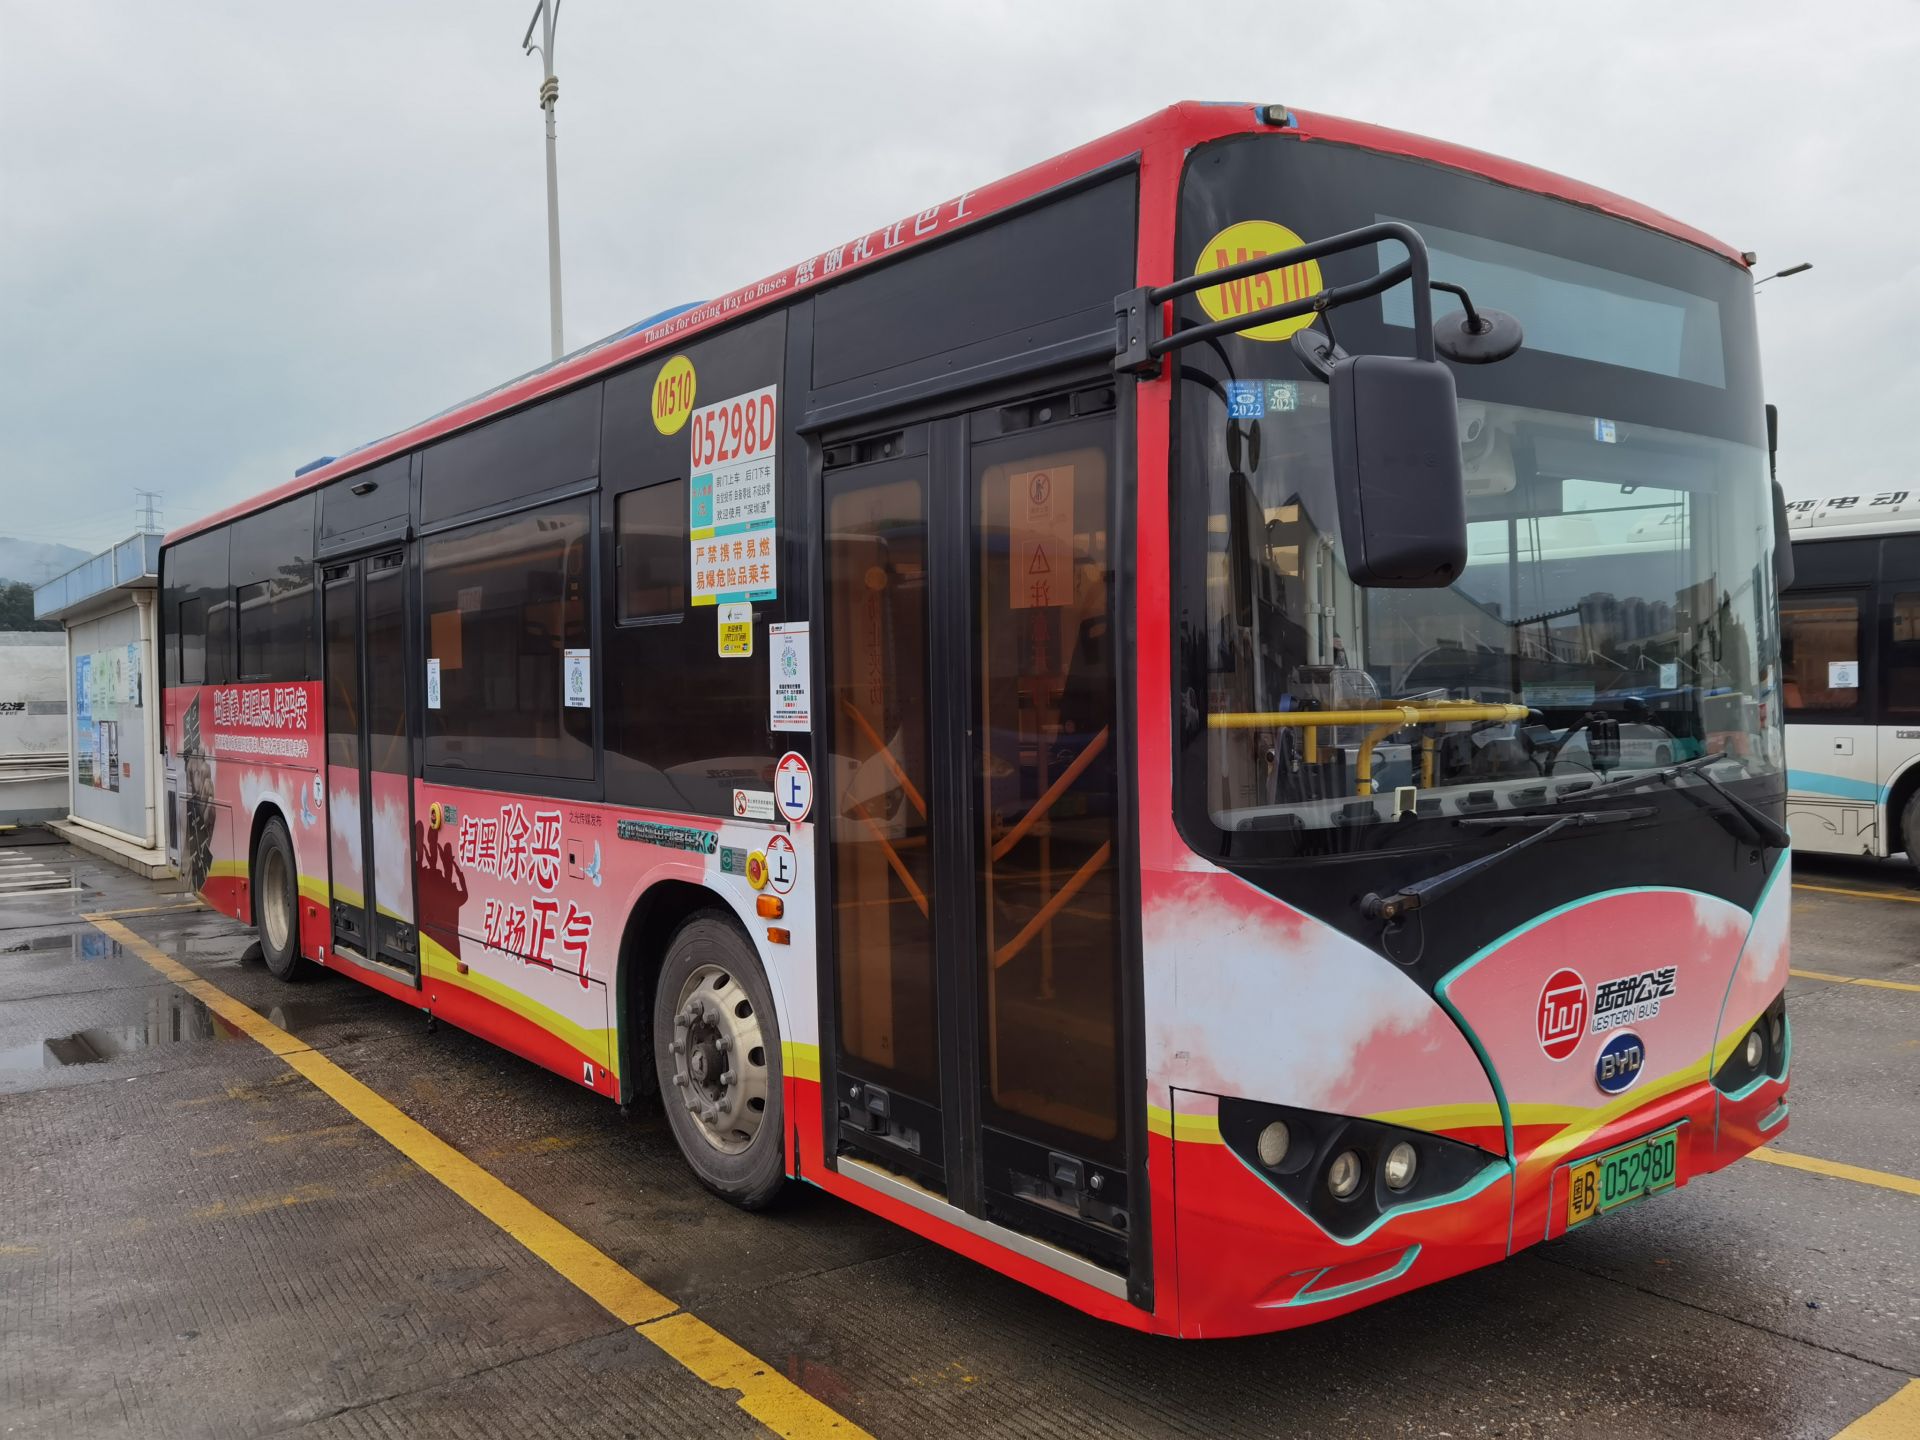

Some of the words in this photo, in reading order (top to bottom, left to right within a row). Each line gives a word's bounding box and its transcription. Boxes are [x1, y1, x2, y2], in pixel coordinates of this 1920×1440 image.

[794, 193, 976, 287] 感谢礼让巴士
[644, 322, 674, 344] Thanks
[676, 317, 689, 331] for
[691, 303, 721, 325] Giving
[722, 295, 742, 312] Way
[744, 289, 754, 303] to
[756, 275, 787, 297] Buses
[656, 370, 692, 419] M510
[1232, 404, 1262, 416] 2022
[1270, 398, 1295, 410] 2021
[691, 393, 775, 468] 05298D
[745, 466, 771, 482] 后门下车
[1785, 491, 1910, 513] 纯电动
[695, 537, 771, 566] 严禁携带易燃
[696, 564, 770, 590] 易爆危险品乘车
[785, 776, 804, 808] 上
[460, 805, 562, 891] 扫黑除恶
[774, 856, 790, 883] 上
[483, 898, 594, 990] 弘扬正气
[1593, 967, 1677, 1015] 西部公汽
[1638, 1001, 1660, 1019] BUS
[1600, 1045, 1641, 1081] BYD
[1572, 1170, 1596, 1214] 粤B
[1604, 1140, 1675, 1201] 05298D
